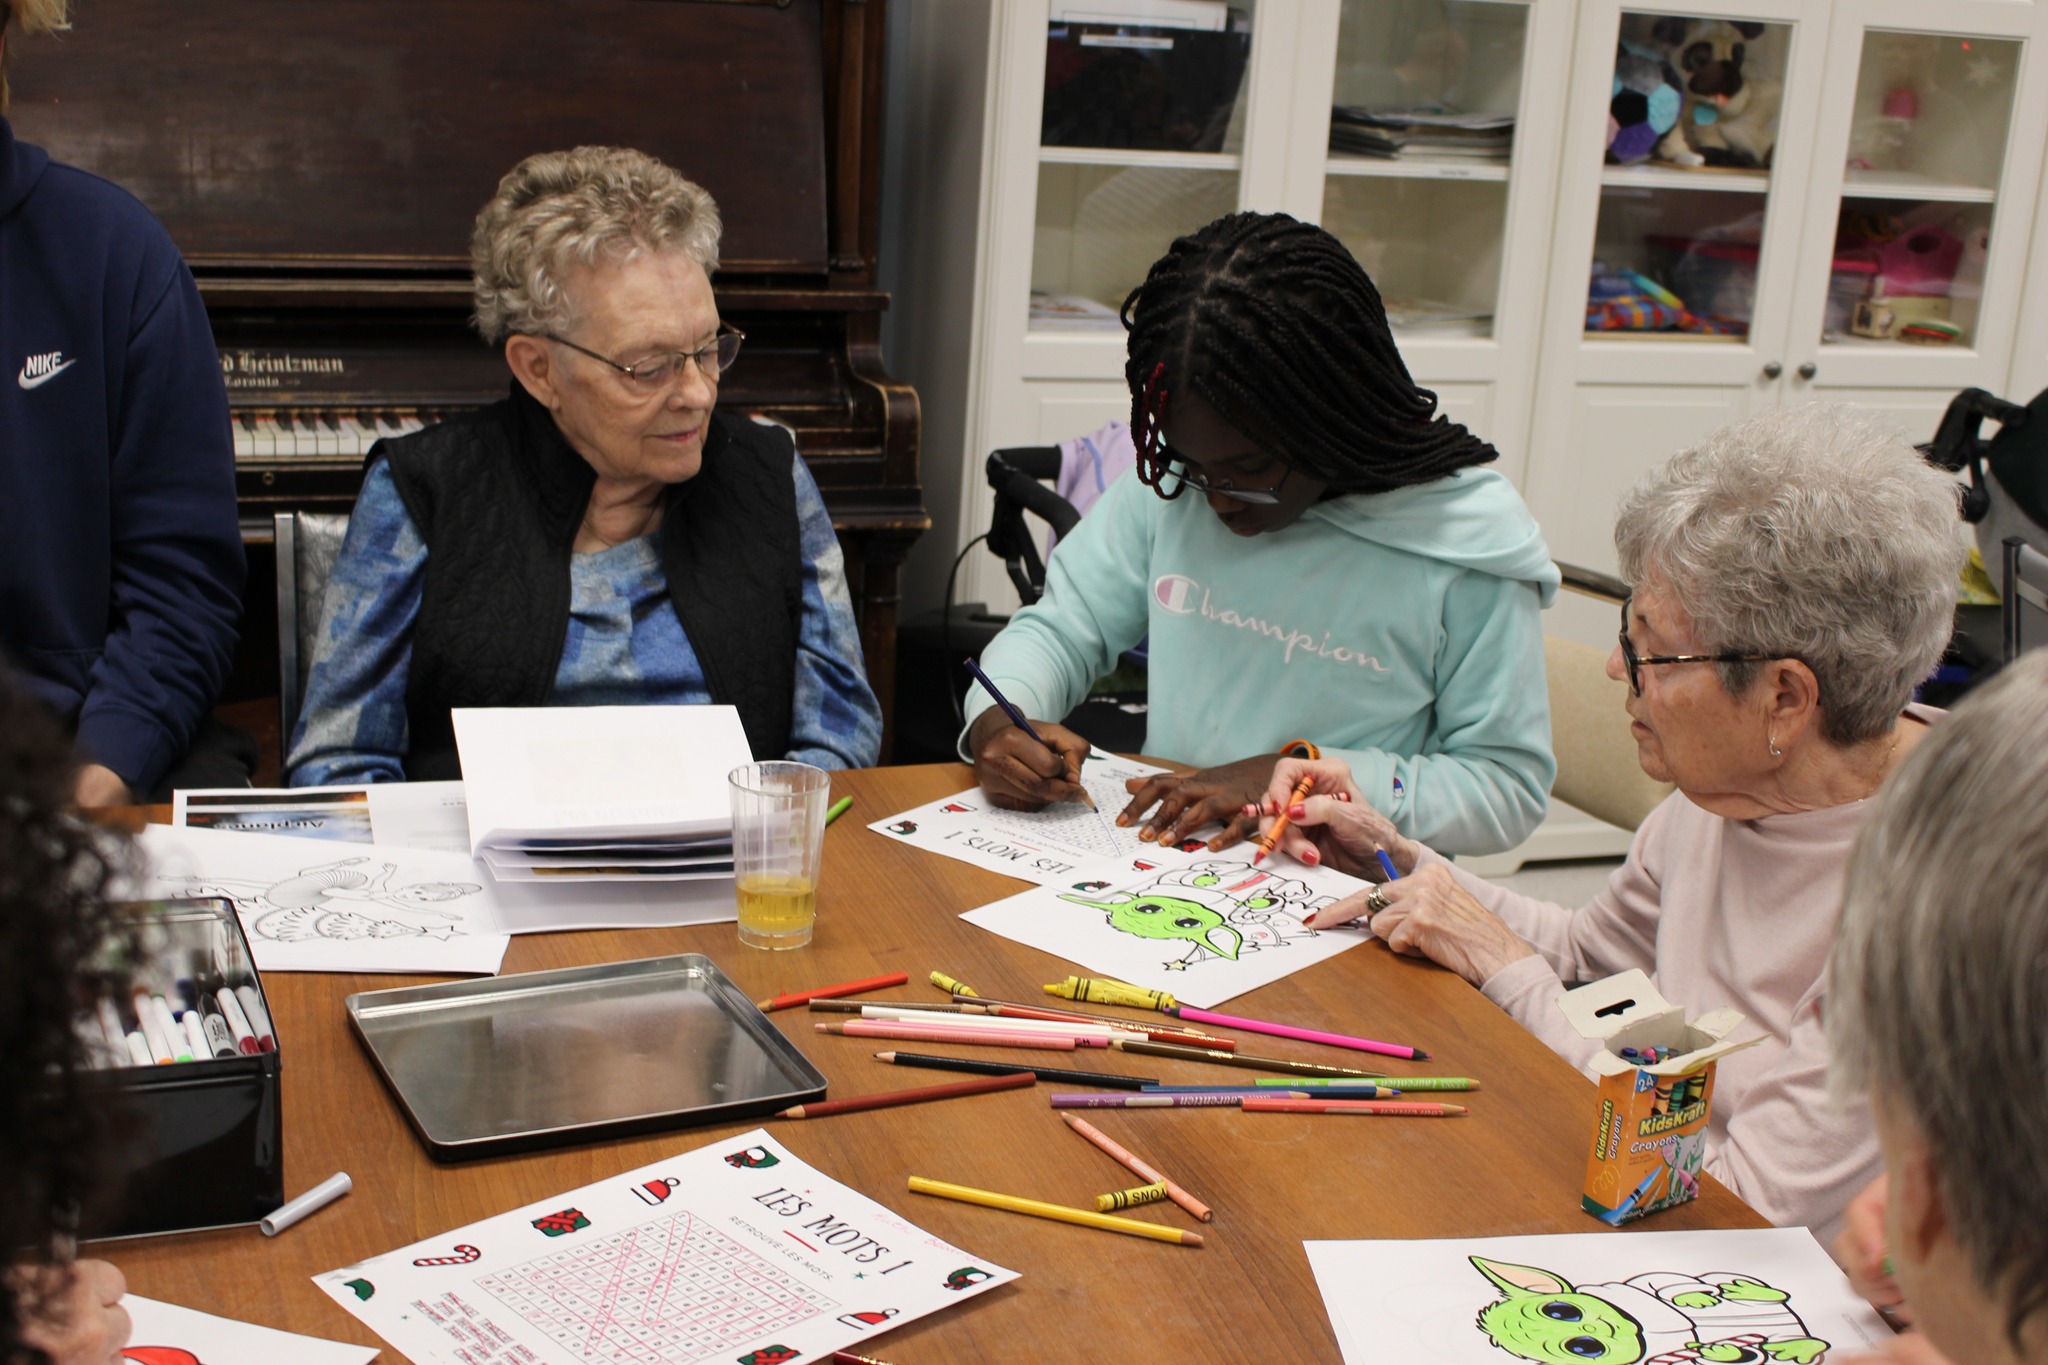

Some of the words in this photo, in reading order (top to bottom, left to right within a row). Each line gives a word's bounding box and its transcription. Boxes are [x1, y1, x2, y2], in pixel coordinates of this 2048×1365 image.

[26, 351, 62, 377] NIKE
[237, 349, 344, 376] Heintzman
[1154, 573, 1391, 672] Champion
[963, 835, 1031, 862] MOTS
[1030, 857, 1075, 875] LES
[1638, 1074, 1654, 1093] 24
[1596, 1098, 1614, 1160] KidsKraft
[1639, 1099, 1707, 1137] KidsKraft
[1608, 1113, 1622, 1160] Crayons
[1630, 1133, 1680, 1154] Crayons
[728, 1215, 783, 1250] RETROUVE
[781, 1246, 801, 1262] LES
[752, 1187, 812, 1217] LES
[802, 1214, 890, 1263] MOTS
[880, 1260, 914, 1275] 1
